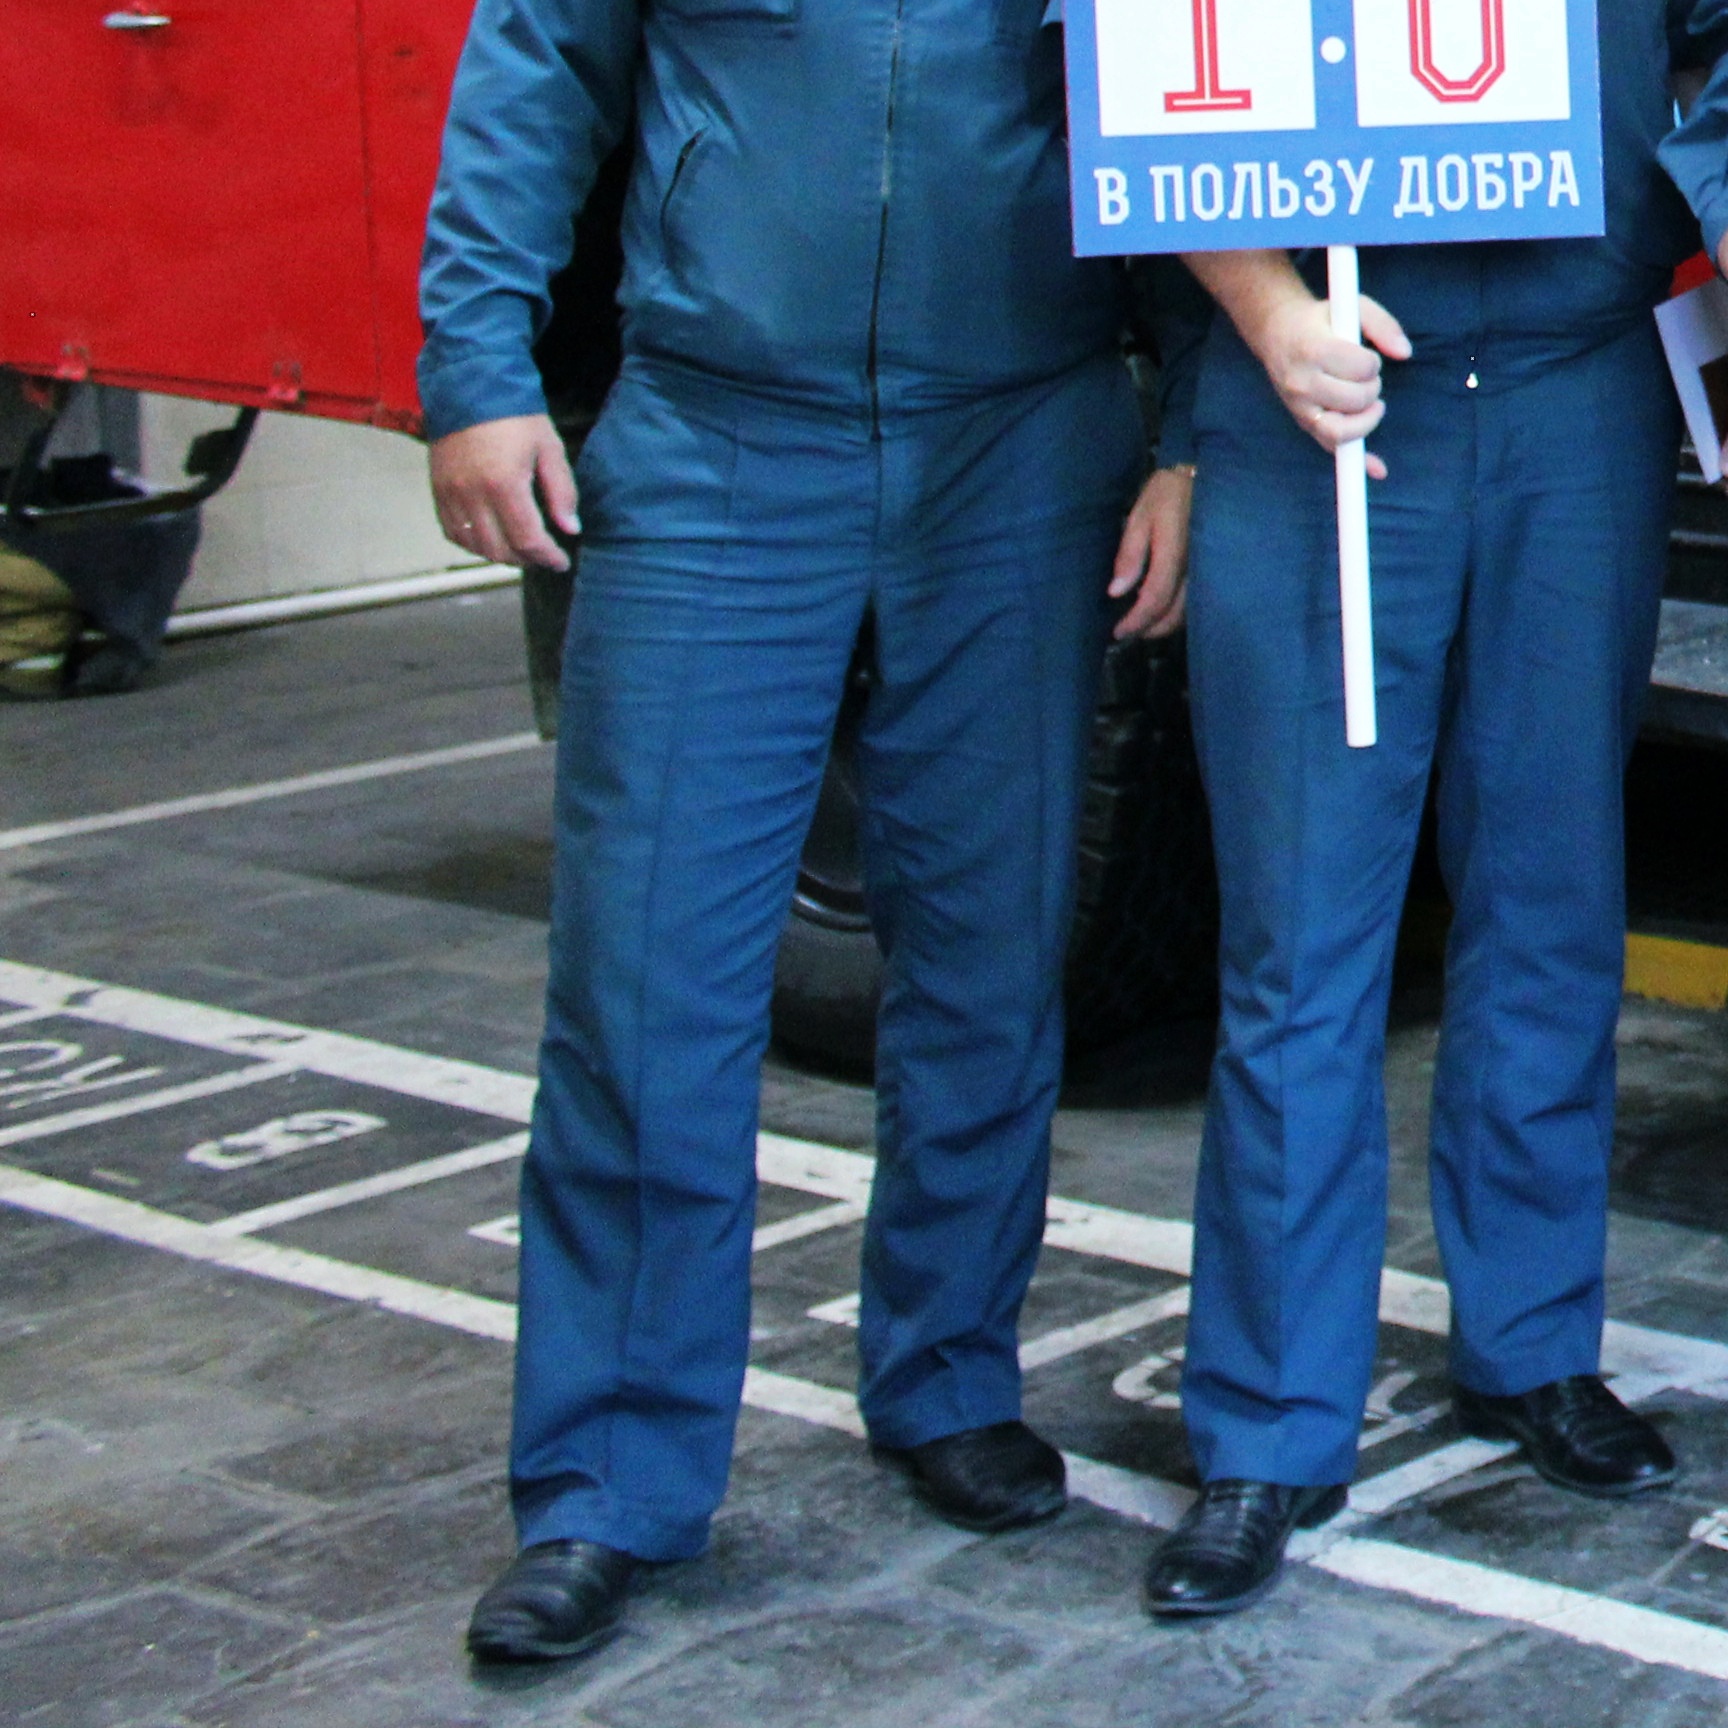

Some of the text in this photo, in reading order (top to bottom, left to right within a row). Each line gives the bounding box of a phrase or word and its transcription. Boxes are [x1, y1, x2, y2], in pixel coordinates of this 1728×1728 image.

[1093, 149, 1581, 226] В ПОЛЬЗУ ДОБРА
